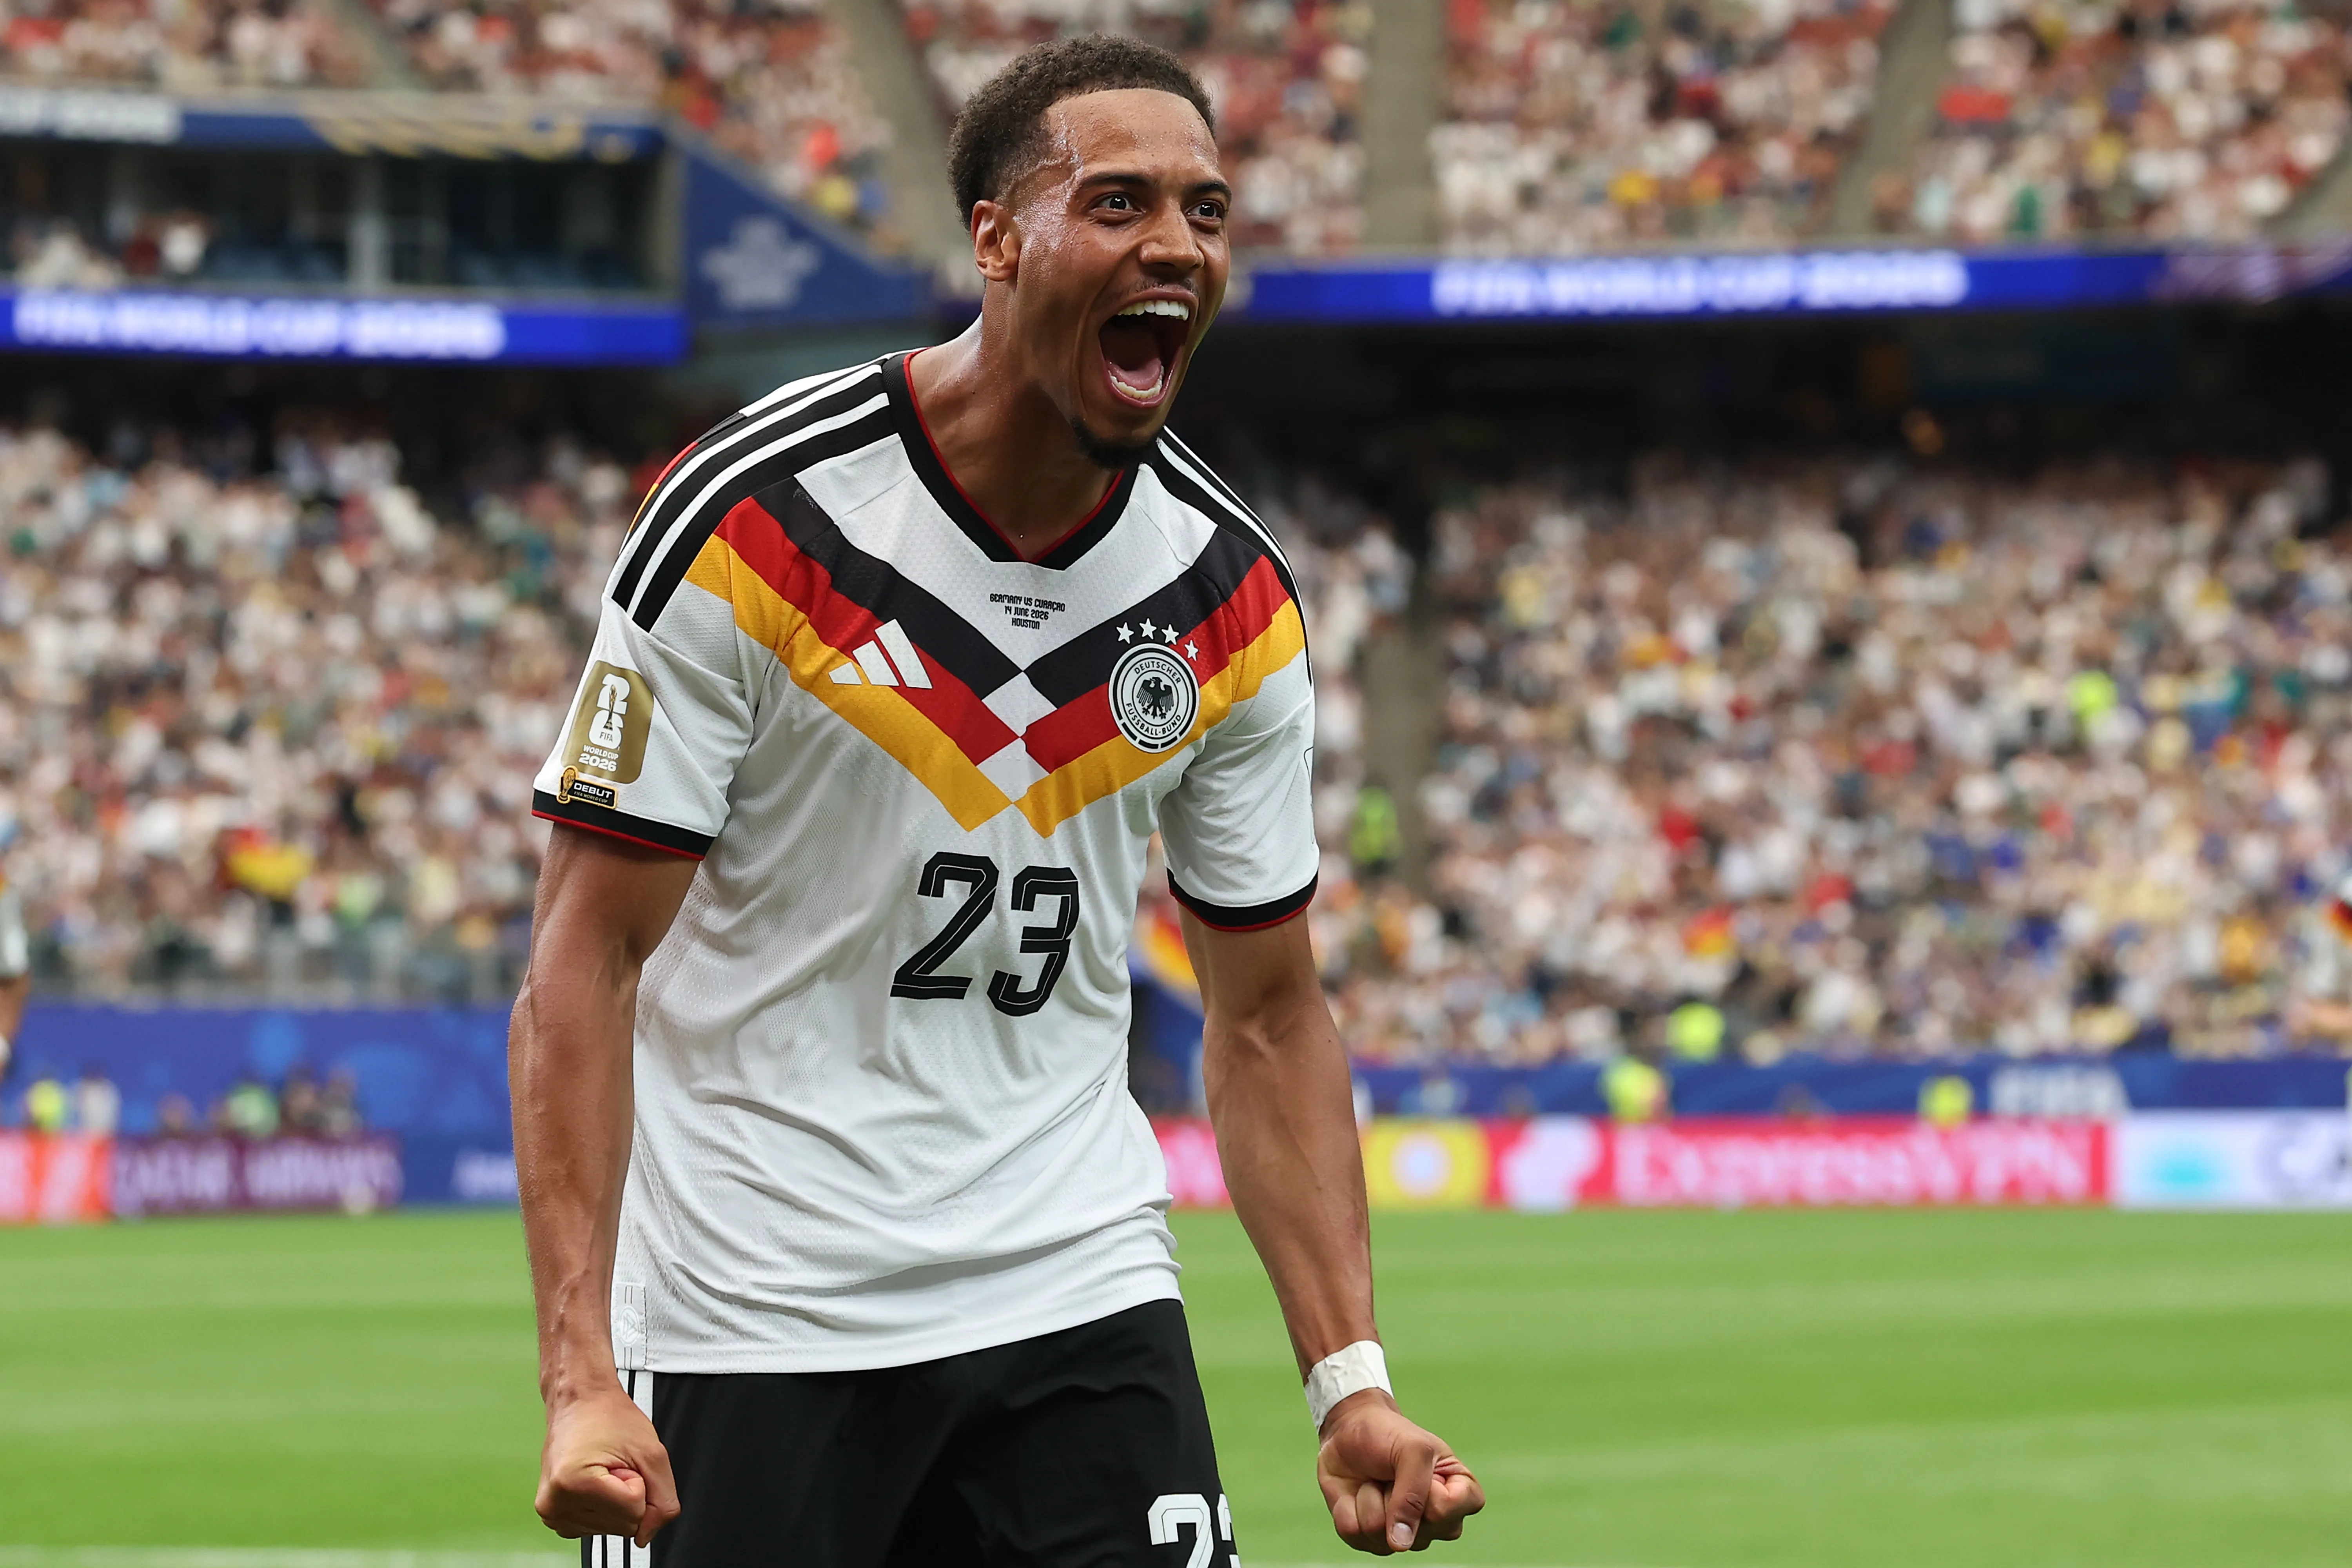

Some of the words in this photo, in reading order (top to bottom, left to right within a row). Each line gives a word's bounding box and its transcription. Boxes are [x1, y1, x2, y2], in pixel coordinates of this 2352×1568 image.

[990, 593, 1022, 604] GERMANY
[1034, 599, 1065, 612] CURAÇAO
[1005, 606, 1012, 614] 14
[1014, 607, 1029, 617] JUNE
[1031, 609, 1049, 620] 2026
[1012, 617, 1040, 630] HOUSTON
[1134, 661, 1181, 684] DEUTSCHER
[599, 731, 613, 742] FIFA
[583, 745, 607, 757] WORLD
[608, 751, 619, 760] CUP
[578, 753, 617, 772] 2026
[573, 782, 613, 798] DEBUT
[890, 851, 1079, 1016] 23
[1147, 1494, 1241, 1568] 2
